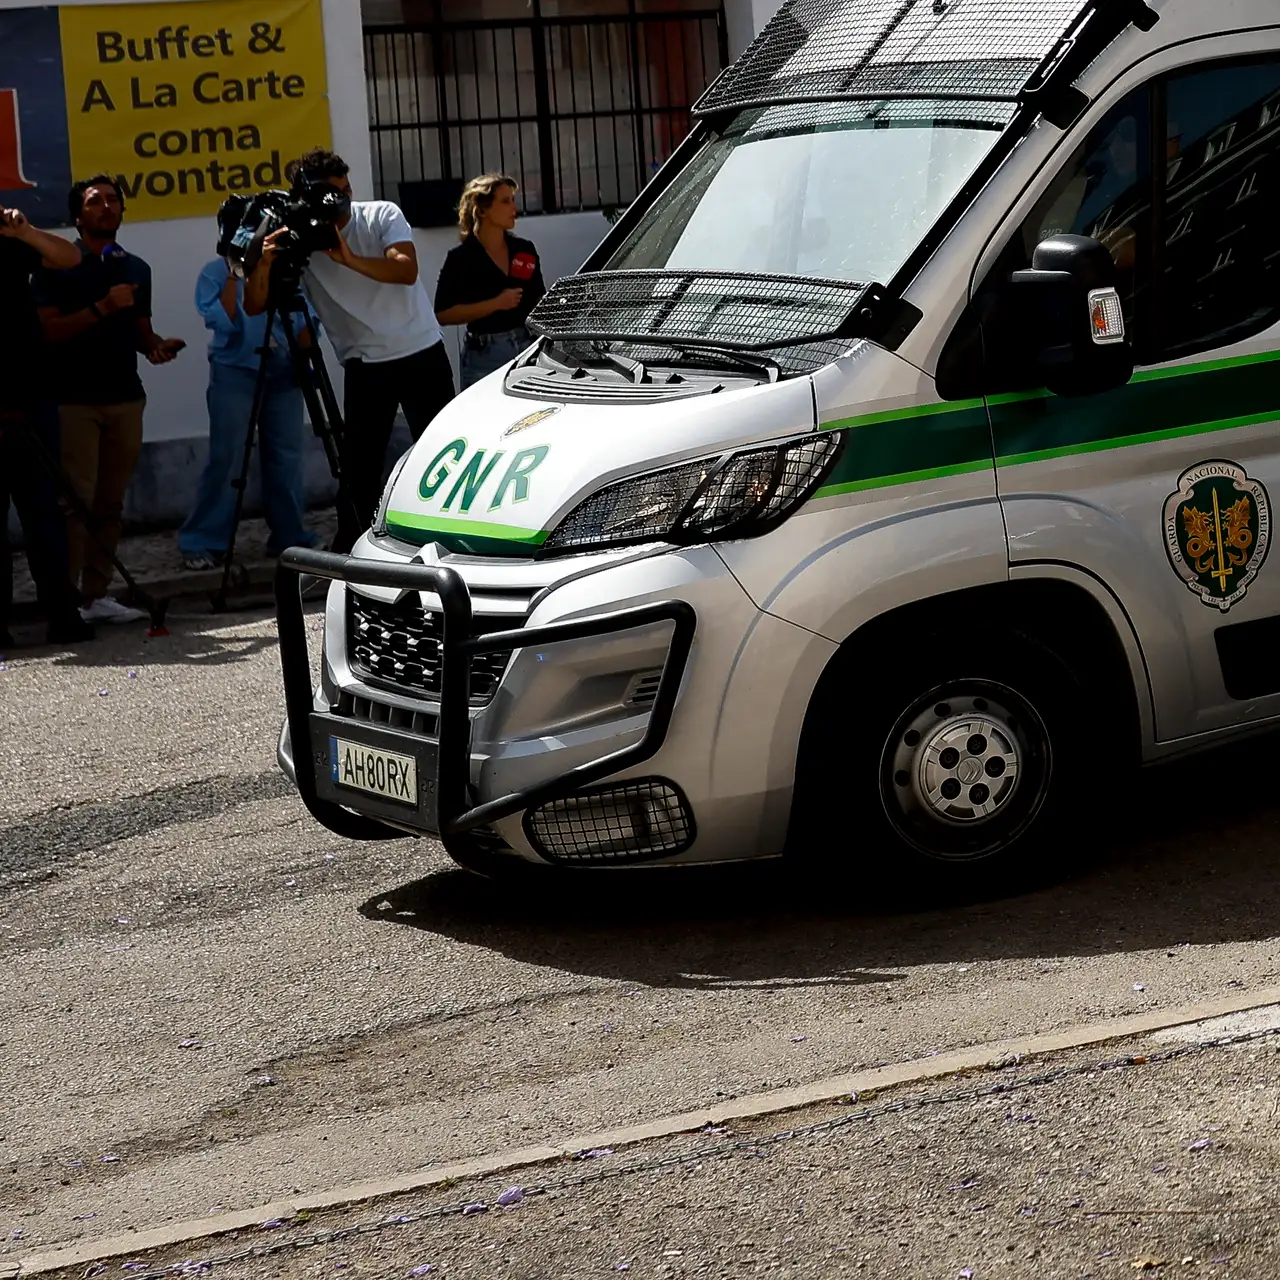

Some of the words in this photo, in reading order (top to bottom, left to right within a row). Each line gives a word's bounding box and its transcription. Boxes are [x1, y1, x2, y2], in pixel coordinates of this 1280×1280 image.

[96, 25, 235, 64] Buffet
[247, 21, 286, 55] &
[80, 79, 116, 114] A
[130, 76, 178, 110] La
[192, 70, 306, 105] Carte
[133, 124, 261, 159] coma
[416, 436, 552, 515] GNR
[1167, 516, 1182, 563] GUARDA
[1186, 465, 1238, 485] NACIONAL
[1250, 485, 1268, 563] REPUBLICANA
